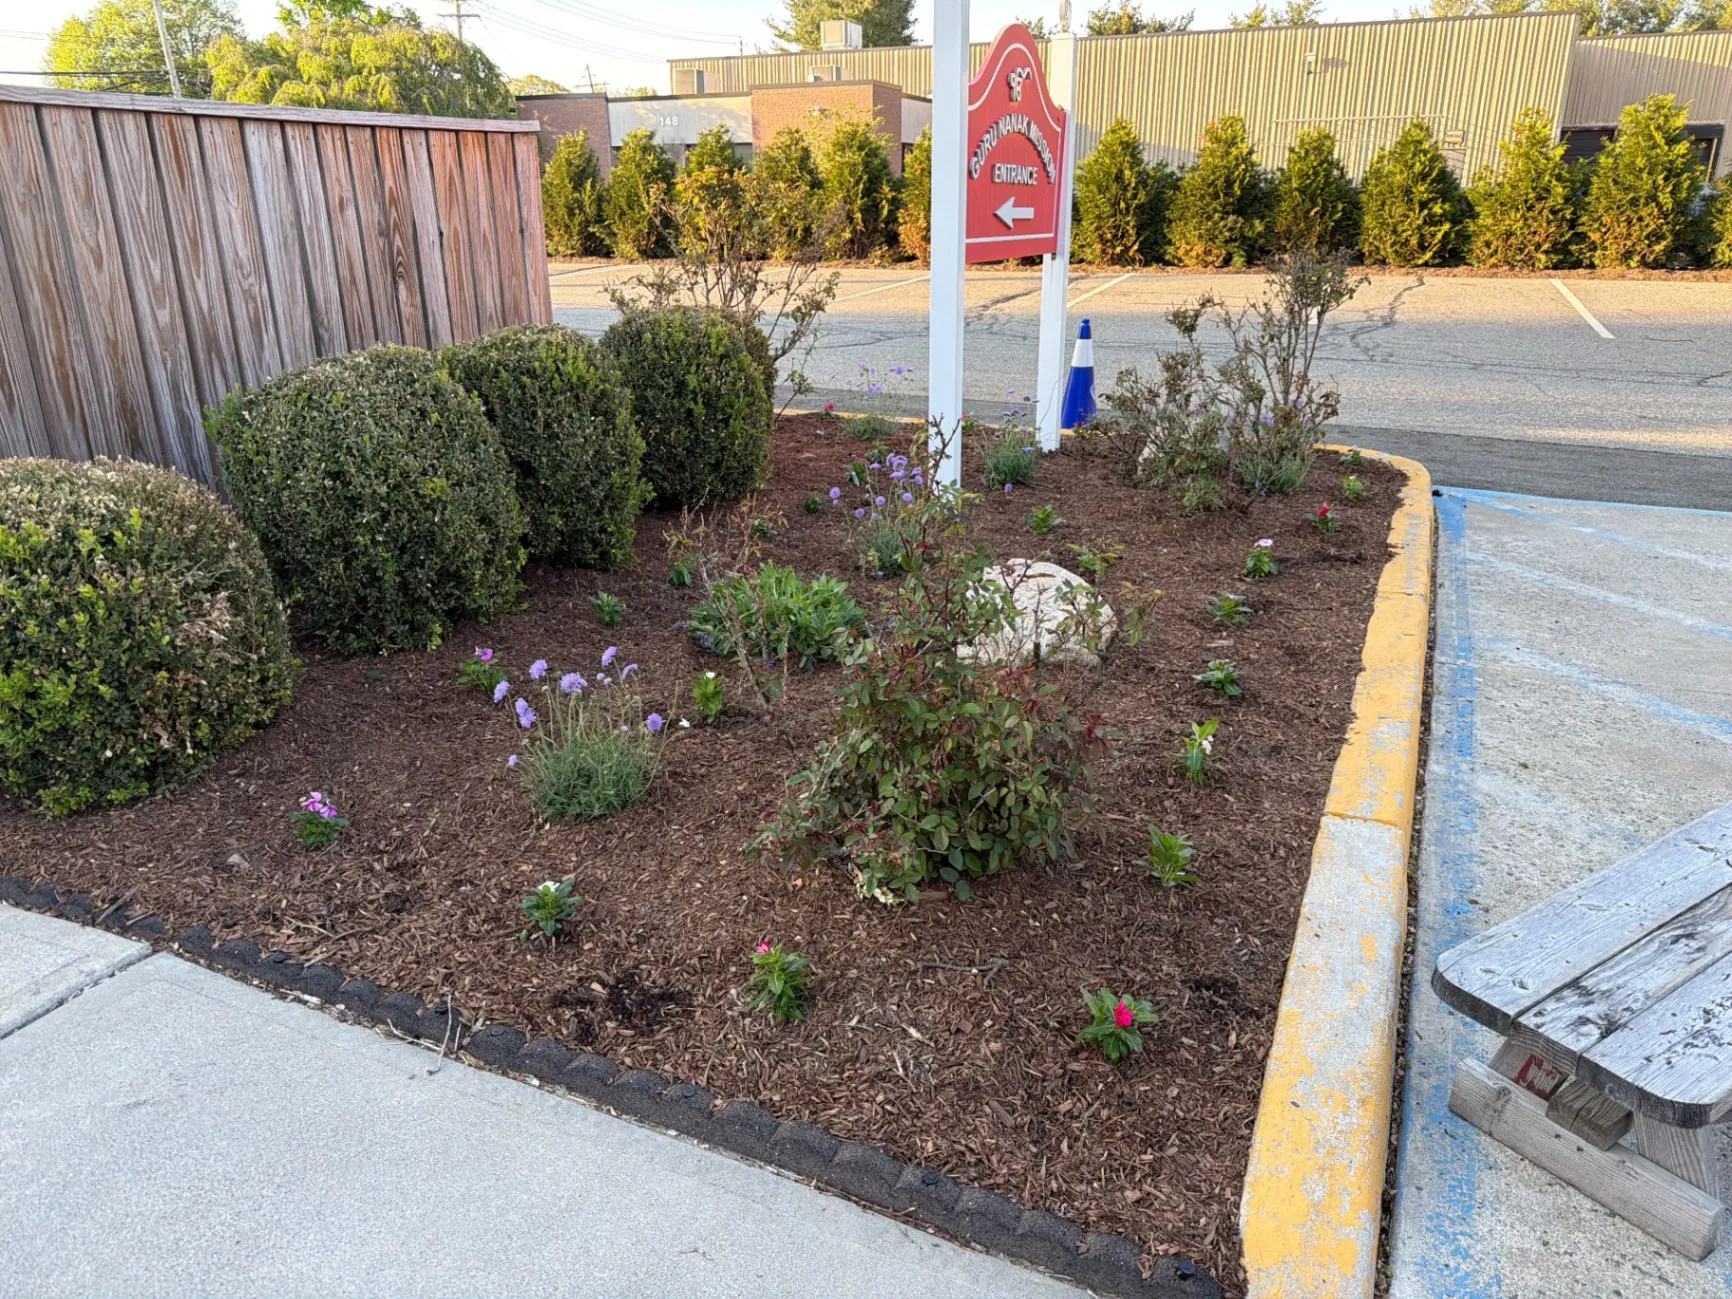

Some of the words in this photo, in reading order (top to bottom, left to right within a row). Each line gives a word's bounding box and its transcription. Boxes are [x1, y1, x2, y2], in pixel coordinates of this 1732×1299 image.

[660, 115, 679, 126] 148
[969, 126, 998, 180] GURU
[998, 113, 1029, 138] NANAK
[1029, 120, 1056, 184] MISSION
[993, 164, 1037, 185] ENTRANCE
